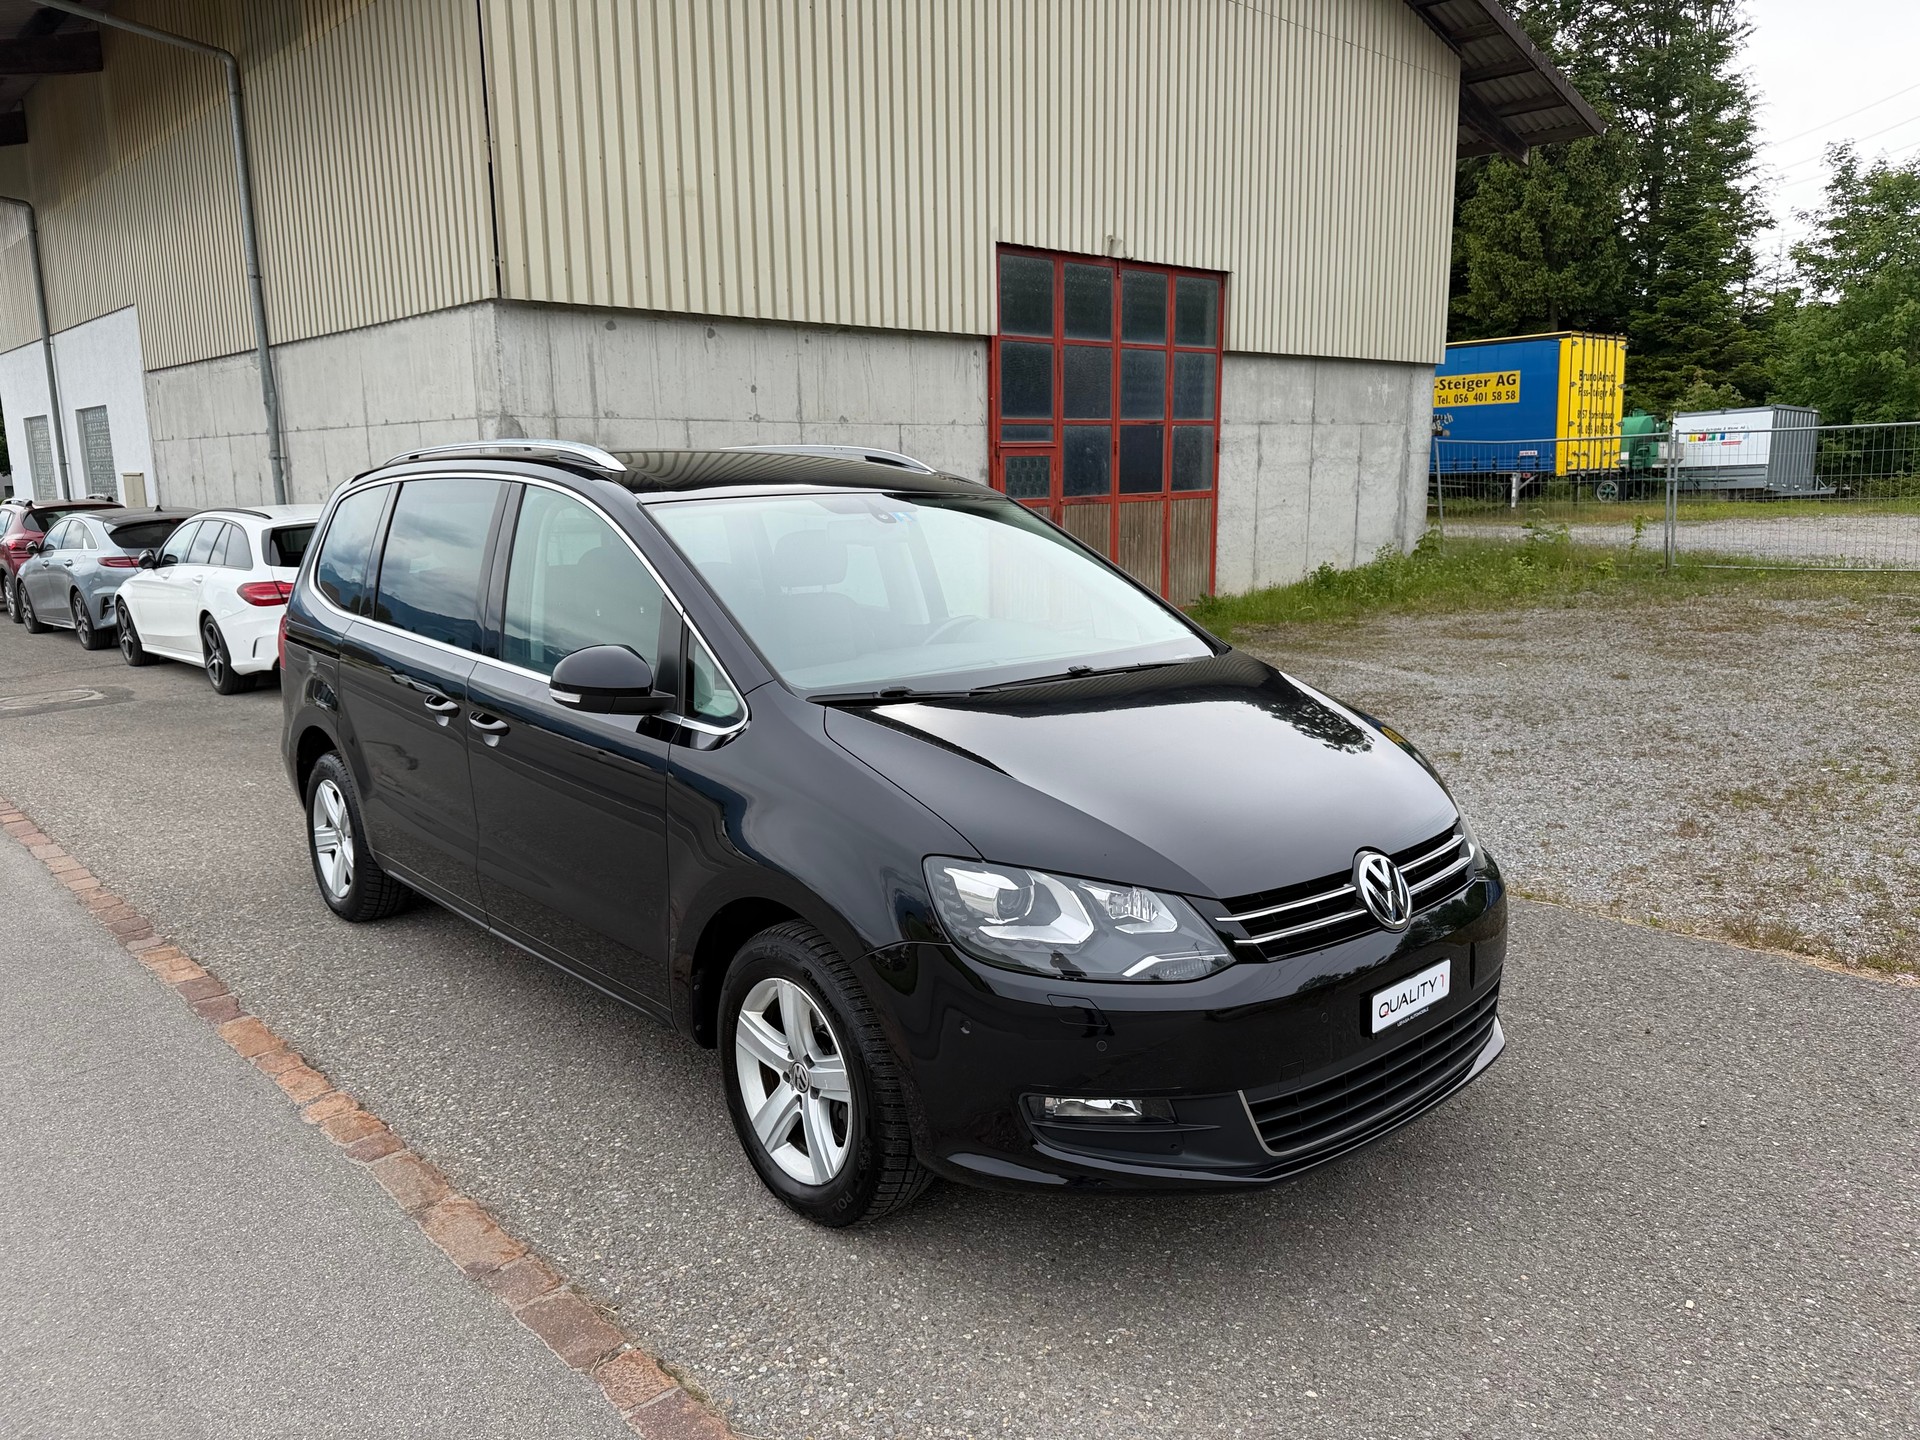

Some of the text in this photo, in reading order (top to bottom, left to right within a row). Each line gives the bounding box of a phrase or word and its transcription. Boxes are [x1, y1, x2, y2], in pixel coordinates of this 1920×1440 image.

[1496, 373, 1517, 386] AG
[1437, 390, 1516, 405] Tel. 056 401 58 58
[1379, 973, 1445, 1019] QUALITY 1
